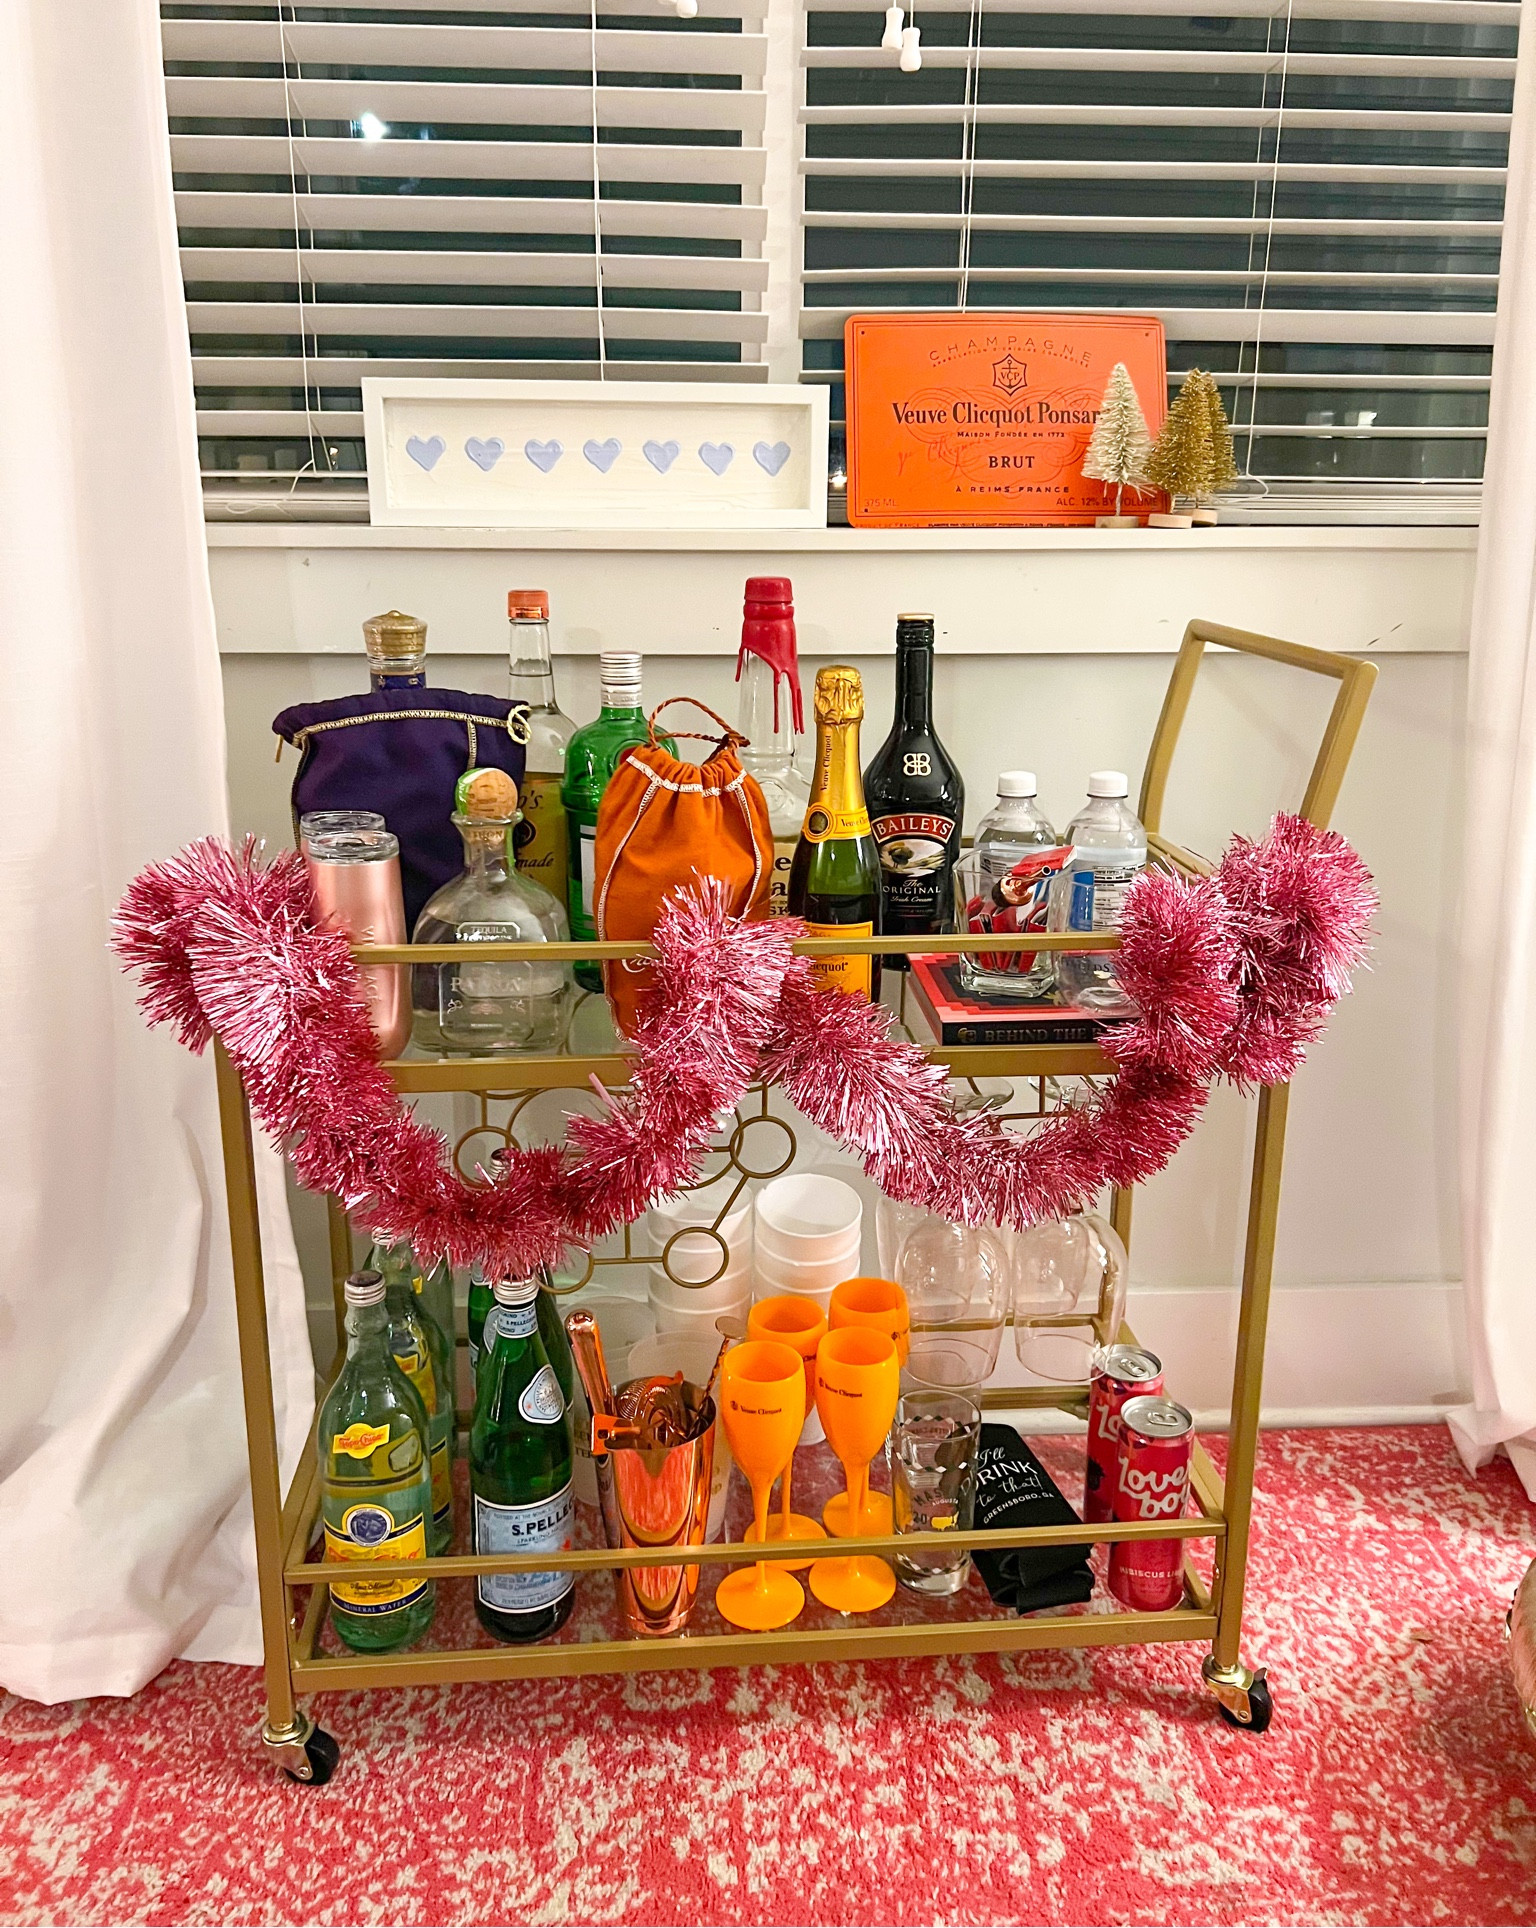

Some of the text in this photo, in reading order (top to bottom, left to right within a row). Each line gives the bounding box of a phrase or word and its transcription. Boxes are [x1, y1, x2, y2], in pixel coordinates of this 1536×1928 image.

[929, 335, 1092, 361] CHAMPAGNE
[891, 401, 1101, 428] Veuve Clicquot Ponsar
[988, 456, 1035, 469] BRUT
[864, 498, 881, 507] 375
[1081, 497, 1100, 506] 12%
[1102, 497, 1116, 506] BY
[823, 735, 833, 769] Clicquot
[876, 817, 951, 836] BAILEYS
[882, 885, 942, 895] ORIGINAL
[903, 879, 924, 888] The
[984, 1028, 1049, 1043] BEHIND
[1053, 1027, 1087, 1041] THE
[976, 1494, 996, 1507] to
[343, 1599, 408, 1613] MINERAL WATER
